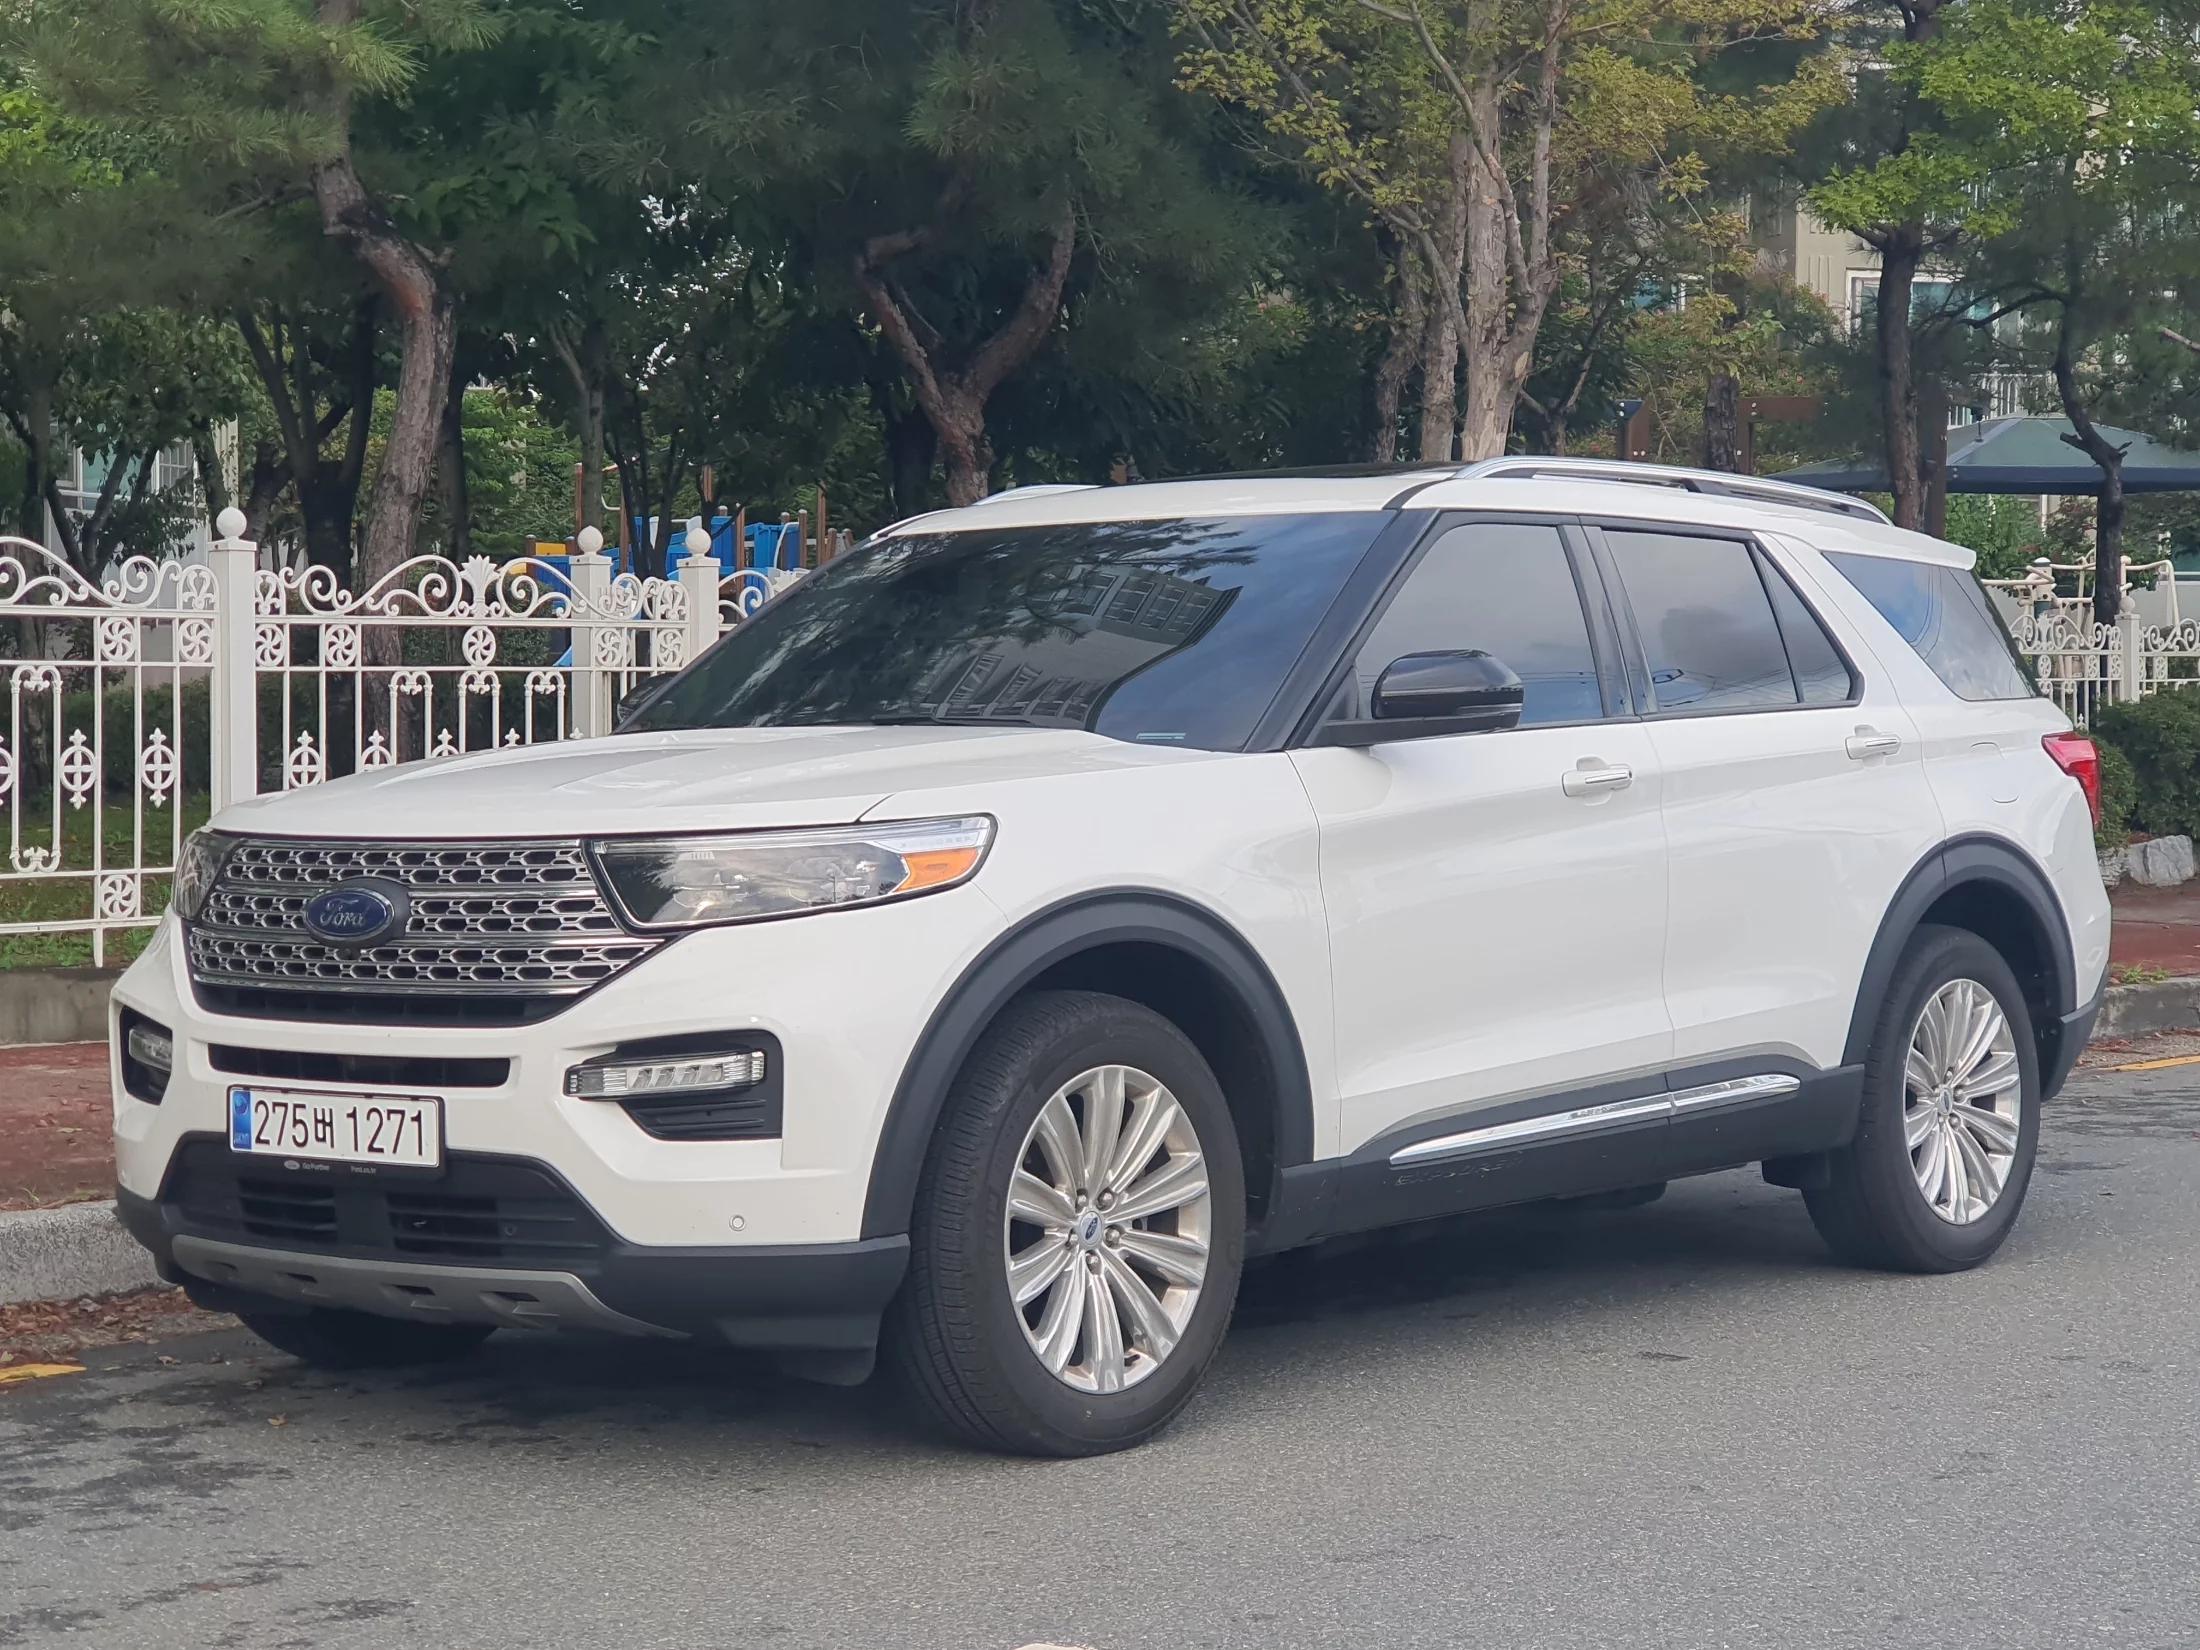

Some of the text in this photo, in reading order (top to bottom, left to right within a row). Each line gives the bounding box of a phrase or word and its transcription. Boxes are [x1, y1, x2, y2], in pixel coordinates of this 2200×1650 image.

[320, 898, 371, 926] Ford
[254, 1099, 424, 1157] 275버 1271
